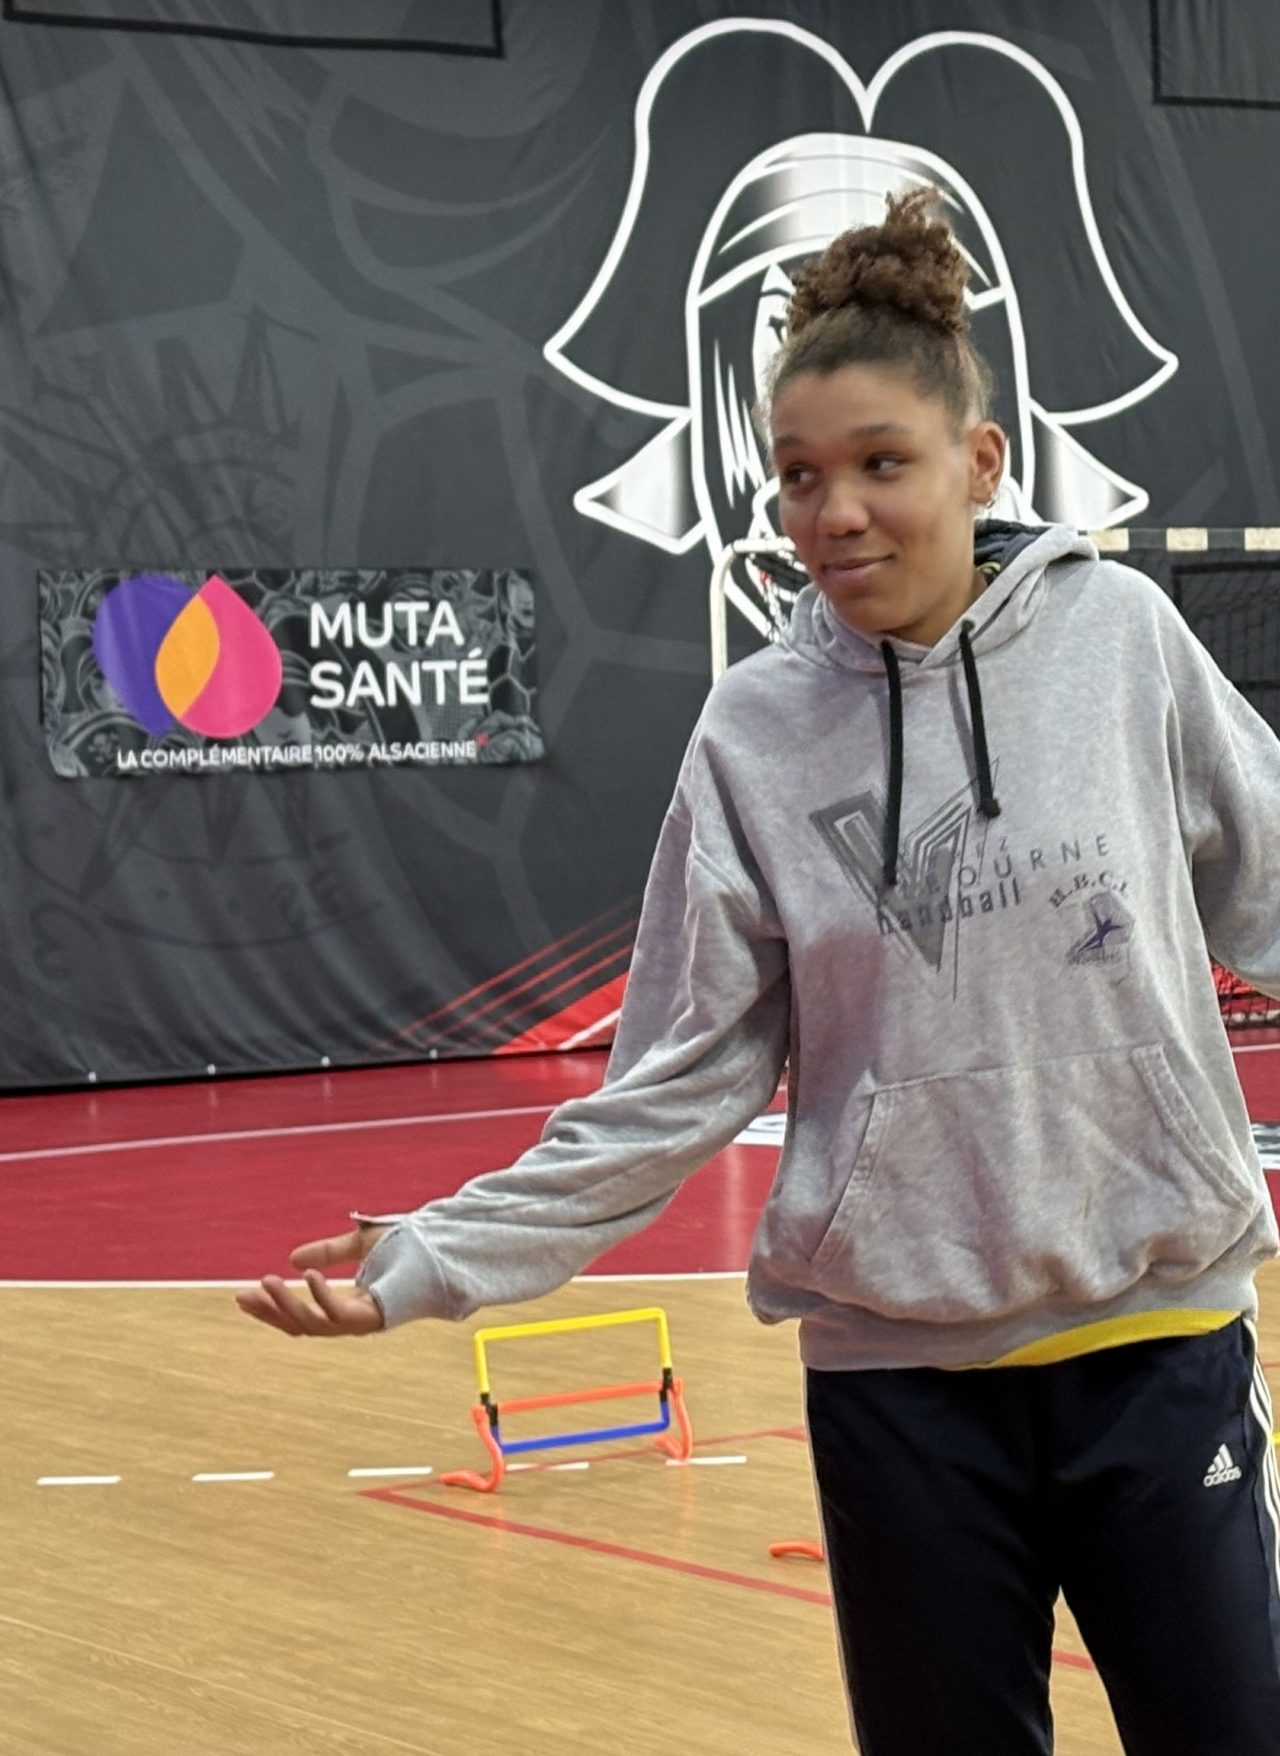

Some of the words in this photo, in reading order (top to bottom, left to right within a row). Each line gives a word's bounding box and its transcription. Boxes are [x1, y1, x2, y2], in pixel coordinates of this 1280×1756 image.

[309, 601, 465, 648] MUTA
[309, 647, 490, 708] SANTÉ
[117, 751, 138, 769] LA
[140, 744, 312, 770] COMPLÉMENTAIRE
[314, 741, 364, 764] 100%
[368, 738, 477, 761] ALSACIENNE
[1203, 1466, 1242, 1487] adidas
